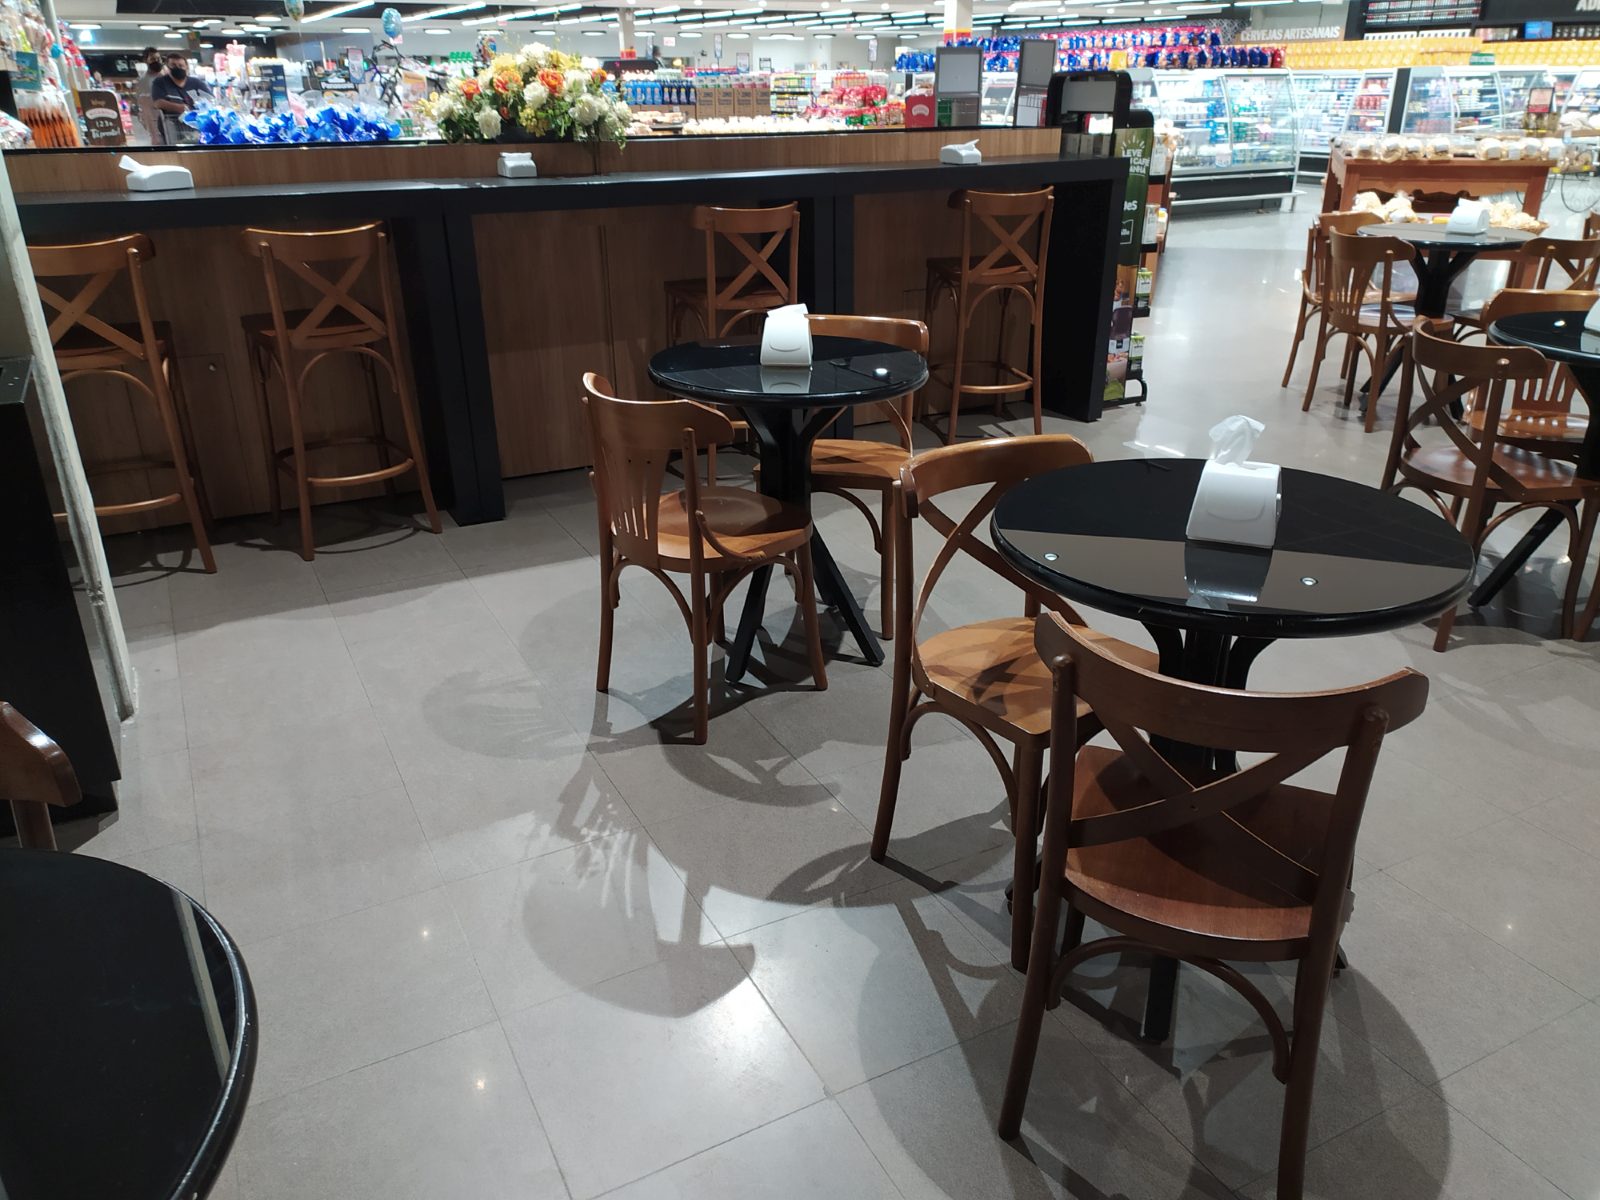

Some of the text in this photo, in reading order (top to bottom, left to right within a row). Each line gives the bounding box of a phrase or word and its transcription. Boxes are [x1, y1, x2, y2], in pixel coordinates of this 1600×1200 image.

[1240, 26, 1340, 42] CERVEJAS ARTESANAIS
[1121, 148, 1142, 158] LEVE
